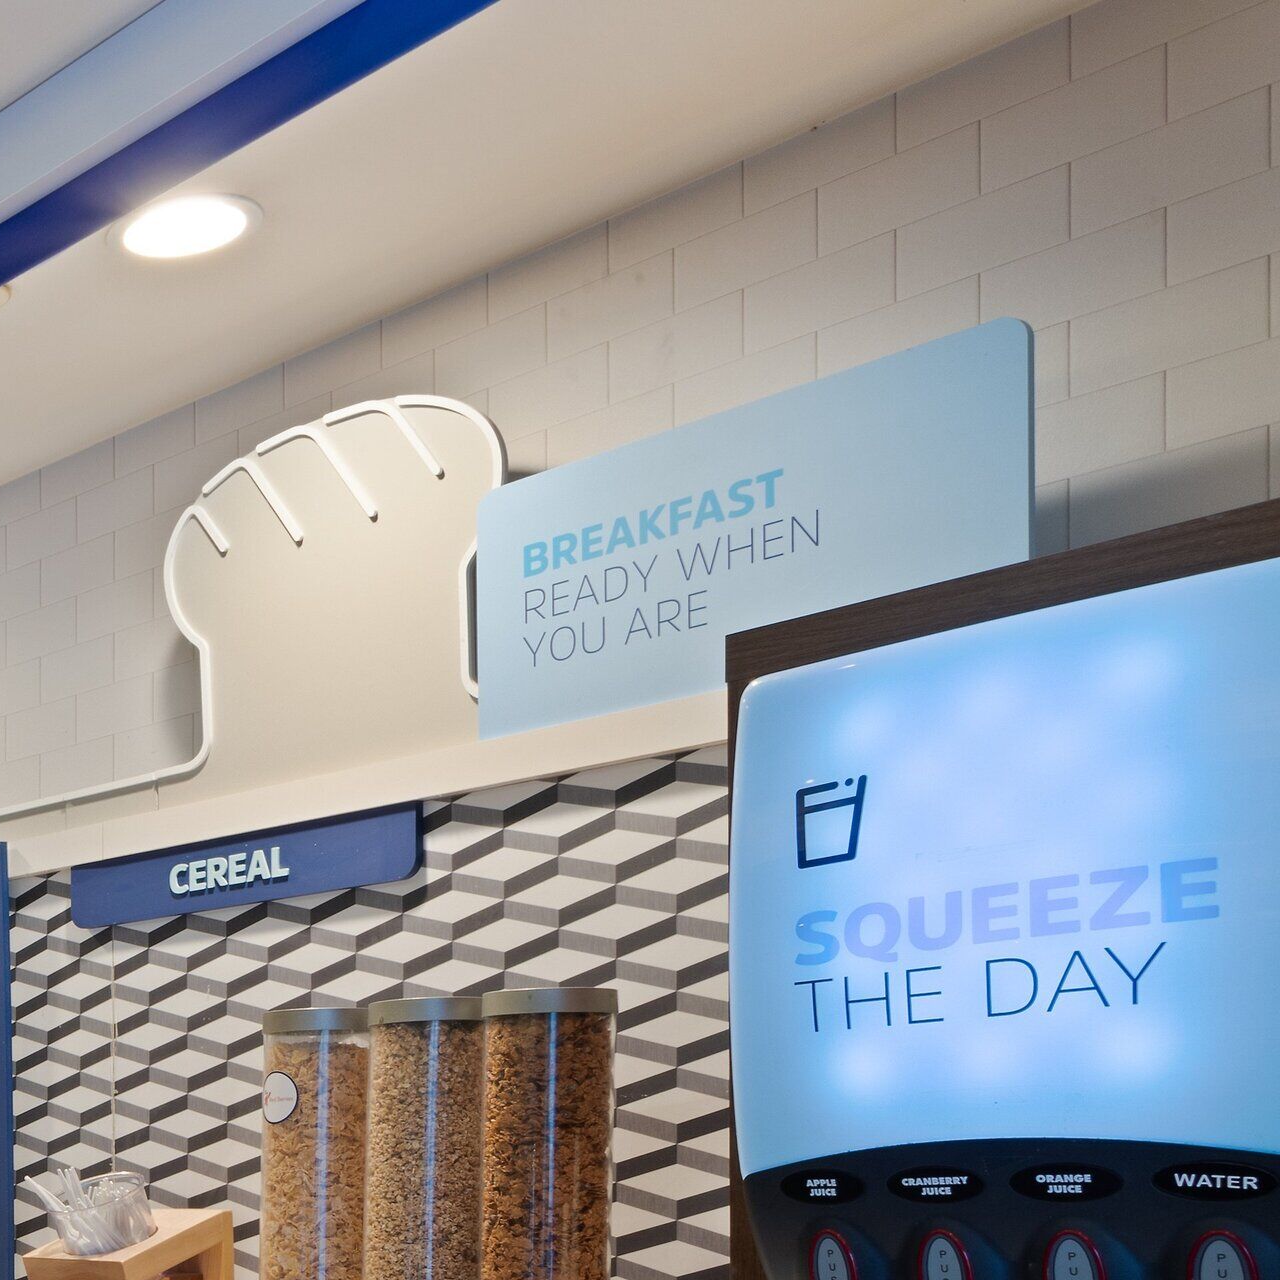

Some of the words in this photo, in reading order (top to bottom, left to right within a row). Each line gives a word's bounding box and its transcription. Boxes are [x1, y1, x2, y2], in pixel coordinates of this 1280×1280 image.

[523, 468, 784, 578] BREAKFAST
[525, 554, 658, 624] READY
[676, 509, 820, 581] WHEN
[523, 616, 606, 667] YOU
[624, 589, 708, 645] ARE
[169, 846, 290, 895] CEREAL
[795, 856, 1220, 966] SQUEEZE
[794, 966, 944, 1032] THE
[985, 941, 1167, 1018] DAY
[806, 1179, 837, 1187] APPLE
[901, 1176, 968, 1186] CRANBERRY
[1035, 1174, 1092, 1183] ORANGE
[1174, 1173, 1258, 1190] WATER
[809, 1188, 837, 1196] JUICE
[921, 1186, 952, 1195] JUICE
[1046, 1184, 1082, 1194] JUICE
